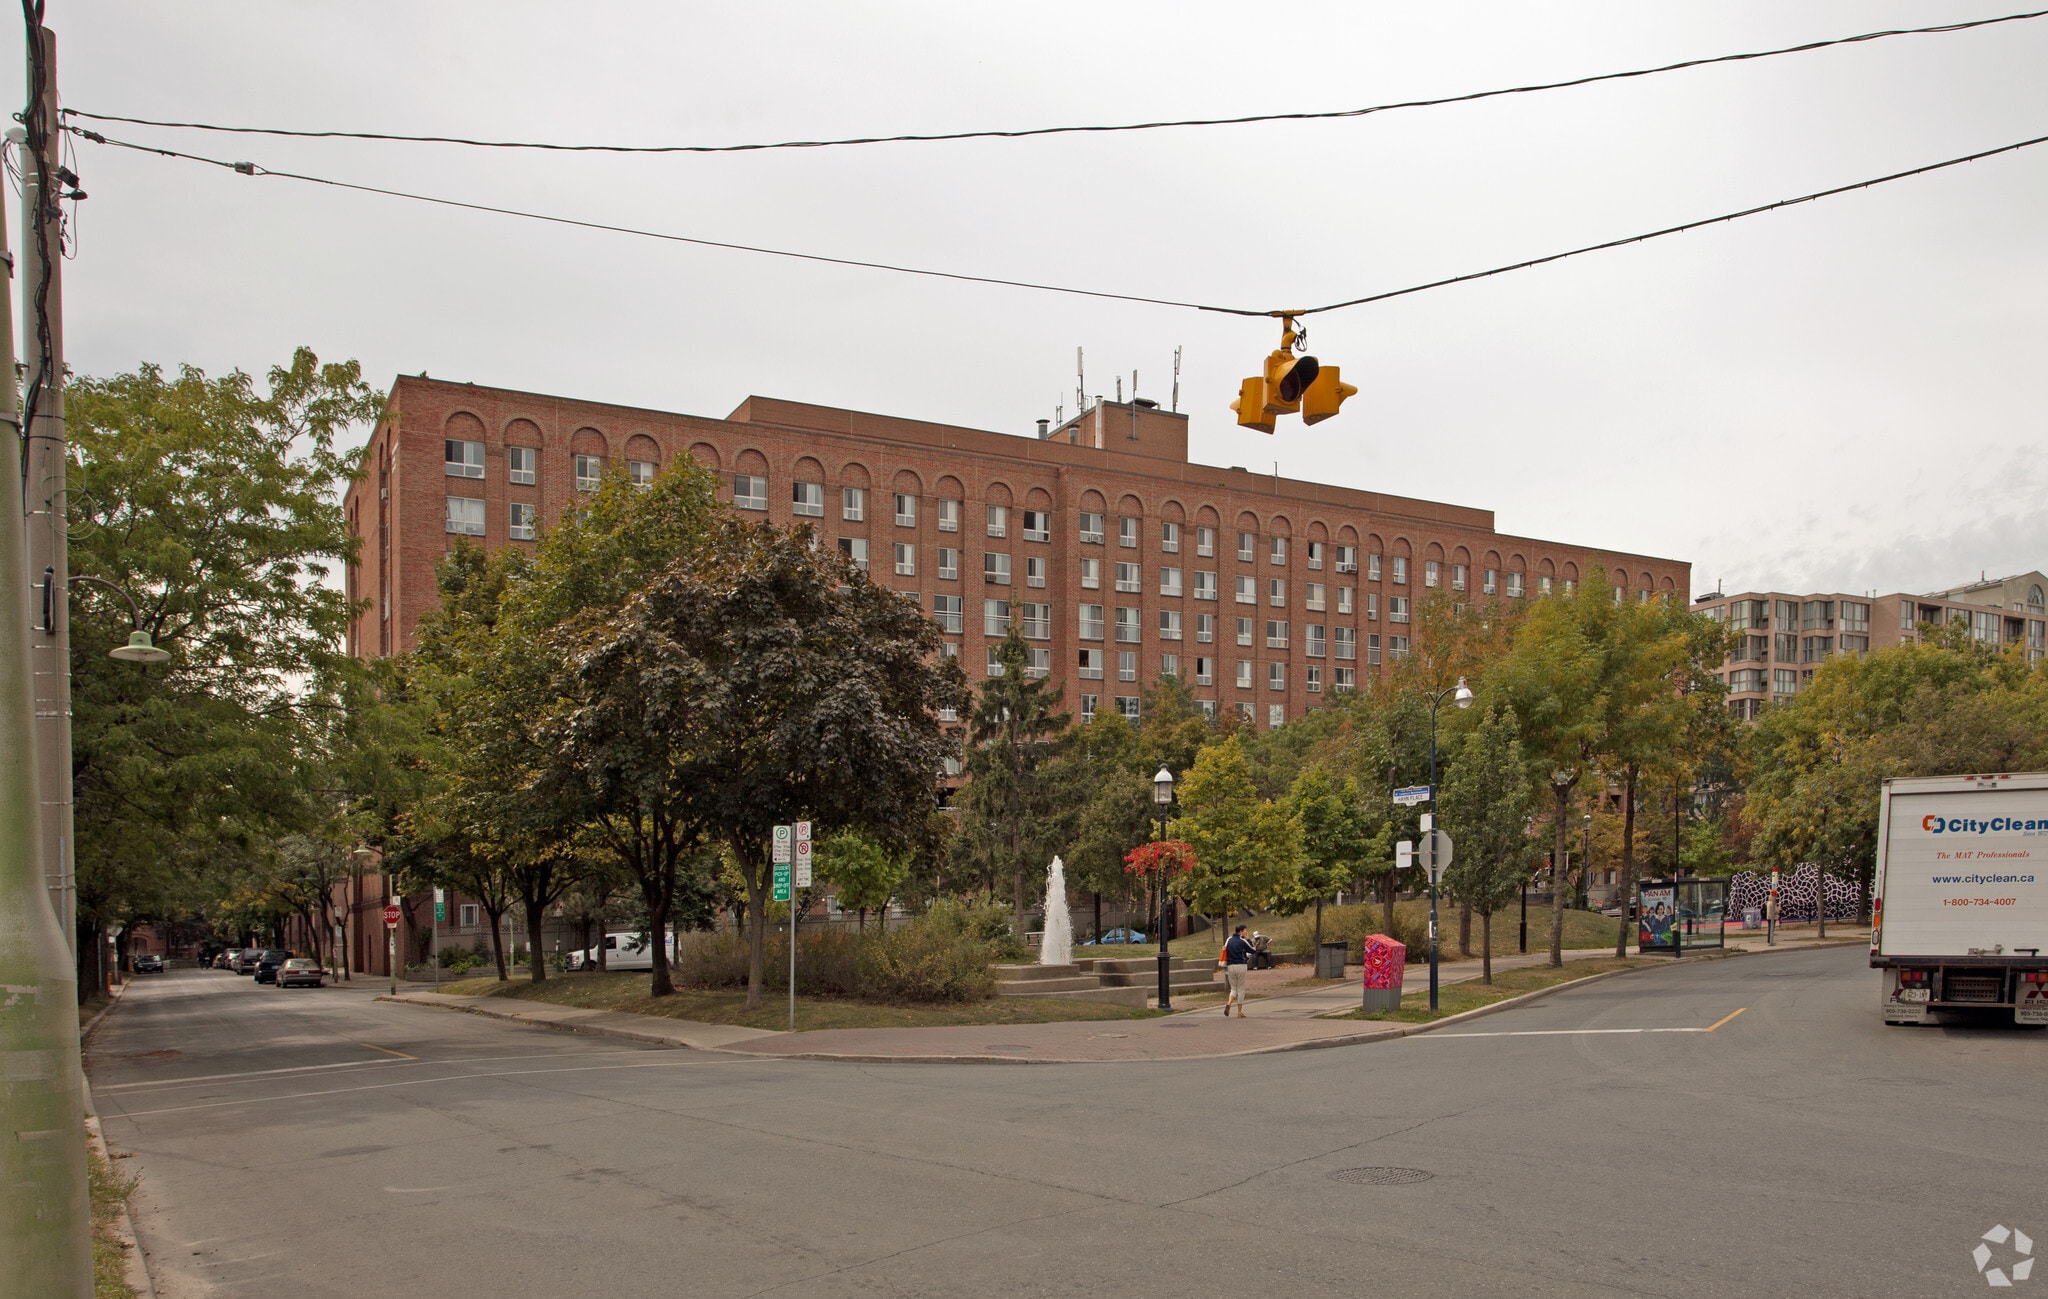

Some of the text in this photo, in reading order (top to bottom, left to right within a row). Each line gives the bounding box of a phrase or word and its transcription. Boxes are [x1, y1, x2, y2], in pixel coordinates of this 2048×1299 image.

[1948, 818, 2048, 834] CityClean
[1954, 851, 1973, 859] MAT
[1976, 850, 2030, 859] Professionals
[1932, 874, 2034, 884] www.cityclean.ca
[1943, 898, 2016, 906] 1-800-734-4007
[383, 911, 400, 919] STOP
